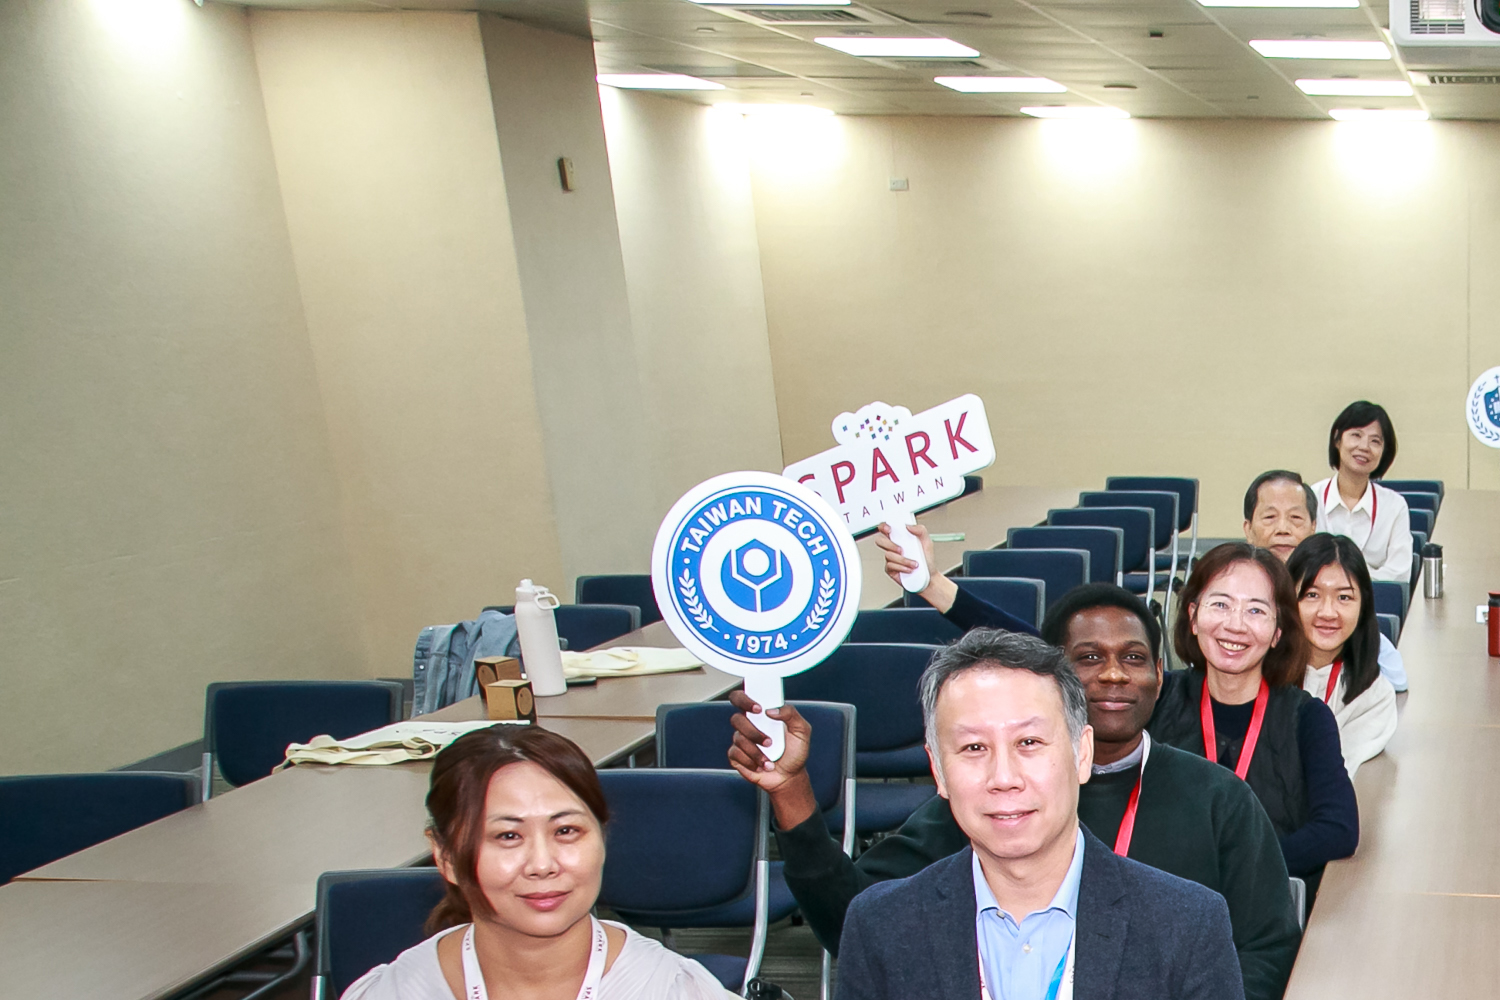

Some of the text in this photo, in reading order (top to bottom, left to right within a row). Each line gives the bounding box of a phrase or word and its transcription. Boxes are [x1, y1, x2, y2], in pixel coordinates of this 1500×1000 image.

[843, 476, 945, 525] TAIWAN
[680, 496, 829, 557] TAIWAN TECH
[734, 631, 789, 655] 1974
